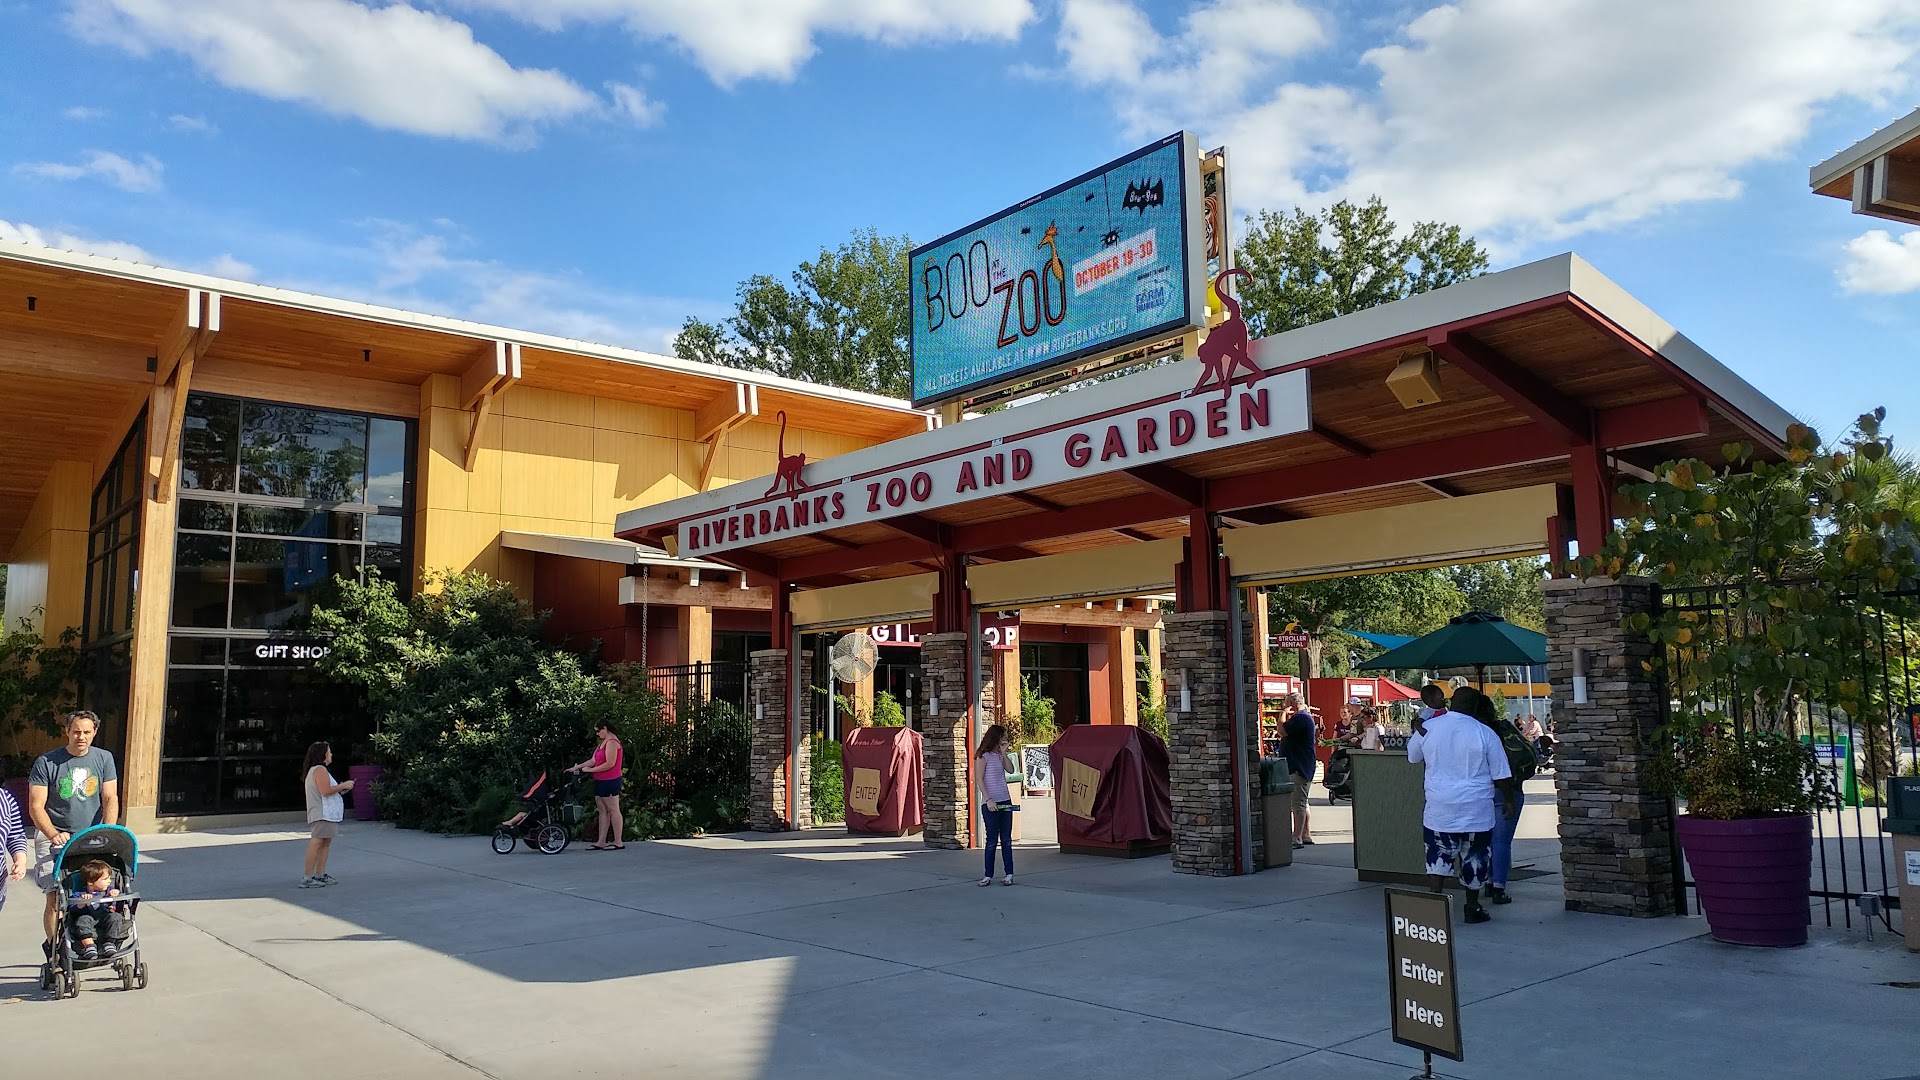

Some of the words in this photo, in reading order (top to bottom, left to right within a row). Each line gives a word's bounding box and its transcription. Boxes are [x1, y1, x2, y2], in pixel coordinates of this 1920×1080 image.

[925, 240, 991, 332] BOO
[1075, 255, 1119, 289] OCTOBER
[993, 258, 1066, 348] ZOO
[939, 366, 968, 388] TICKETS
[971, 353, 1012, 378] AVAILABLE
[688, 491, 846, 550] RIVERBANKS
[866, 471, 933, 513] ZOO
[956, 448, 1034, 494] AND
[1064, 388, 1271, 469] GARDEN
[255, 644, 289, 659] GIFT
[291, 645, 332, 659] SHOP
[1383, 737, 1404, 747] ZOO
[855, 785, 877, 800] ENTER
[1394, 916, 1448, 945] Please
[1401, 957, 1444, 986] Enter
[1405, 998, 1444, 1029] Here
